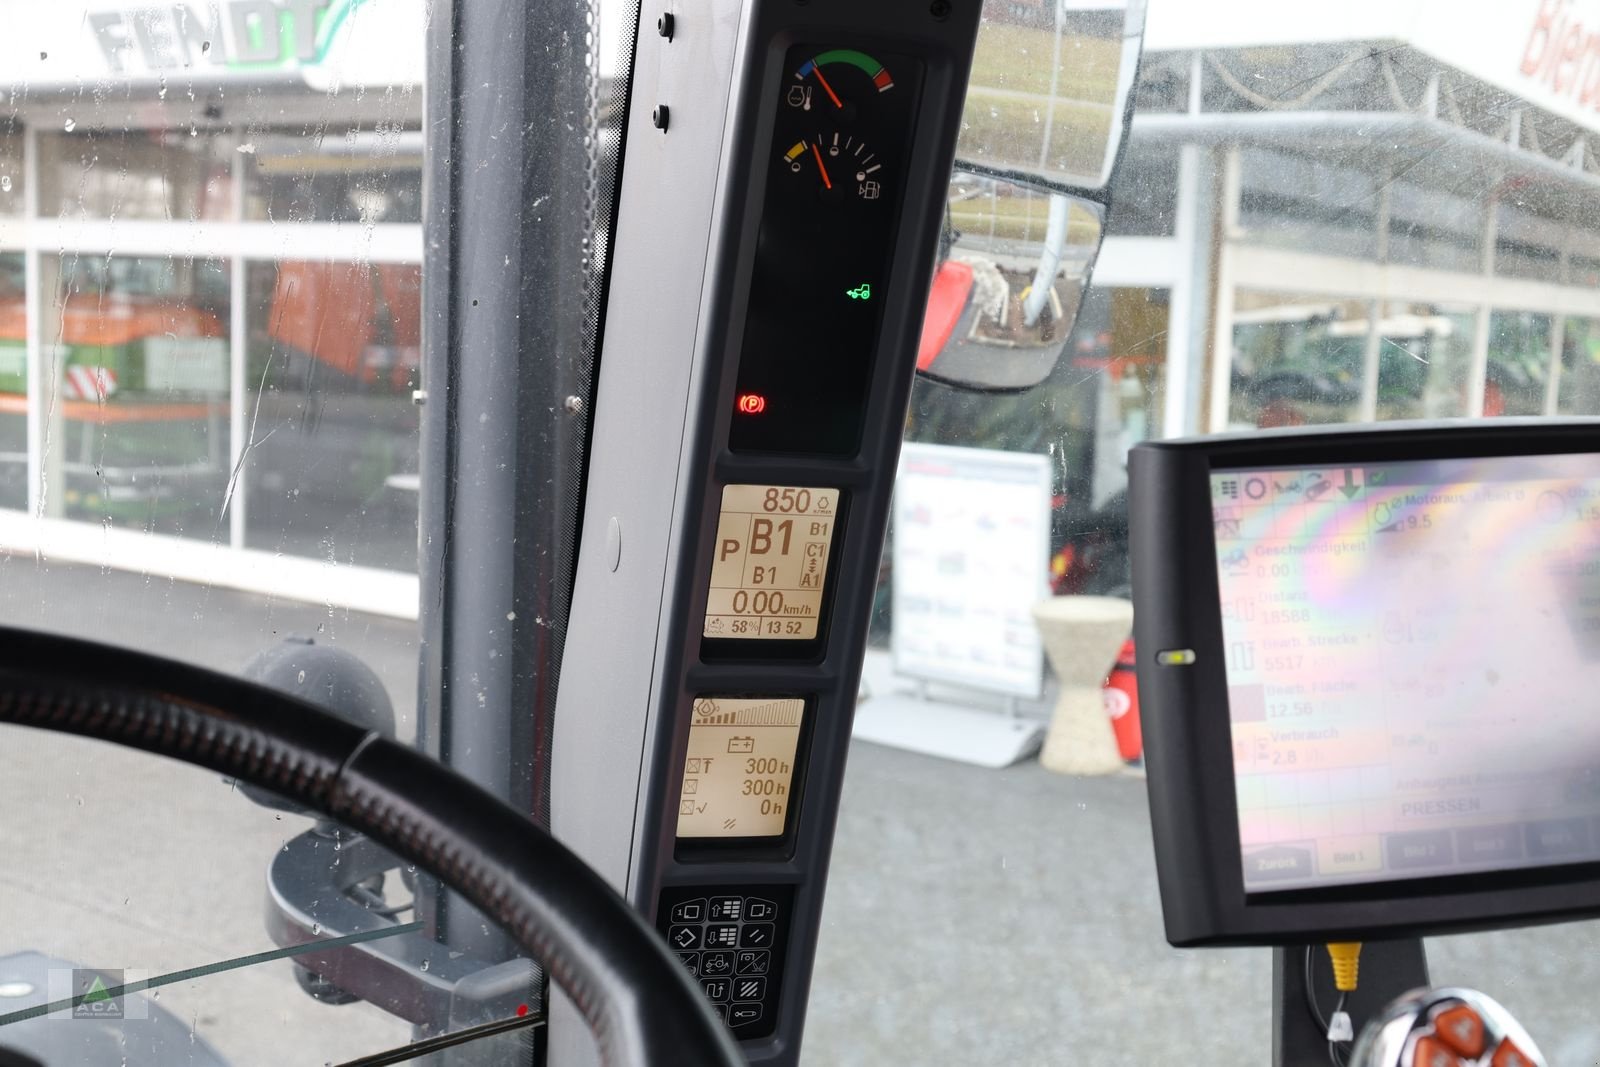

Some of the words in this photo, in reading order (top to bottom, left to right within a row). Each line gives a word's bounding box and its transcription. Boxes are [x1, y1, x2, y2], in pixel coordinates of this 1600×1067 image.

[88, 0, 330, 71] FENDT
[763, 488, 811, 513] 850
[750, 518, 793, 556] B1
[809, 522, 828, 536] B1
[720, 539, 740, 562] P
[807, 544, 824, 557] C1
[752, 566, 777, 585] B1
[801, 573, 819, 586] A1
[1256, 564, 1290, 579] 0.00
[732, 590, 784, 615] 0.00
[784, 602, 811, 615] km/h
[1264, 655, 1304, 672] 5517
[1268, 701, 1314, 719] 12.56
[745, 758, 778, 774] 300
[780, 761, 789, 774] h
[1272, 749, 1298, 766] 2.8
[742, 779, 774, 796] 300
[776, 783, 785, 795] h
[760, 799, 771, 815] 0
[773, 802, 782, 814] h
[1401, 797, 1480, 816] PRESSEN
